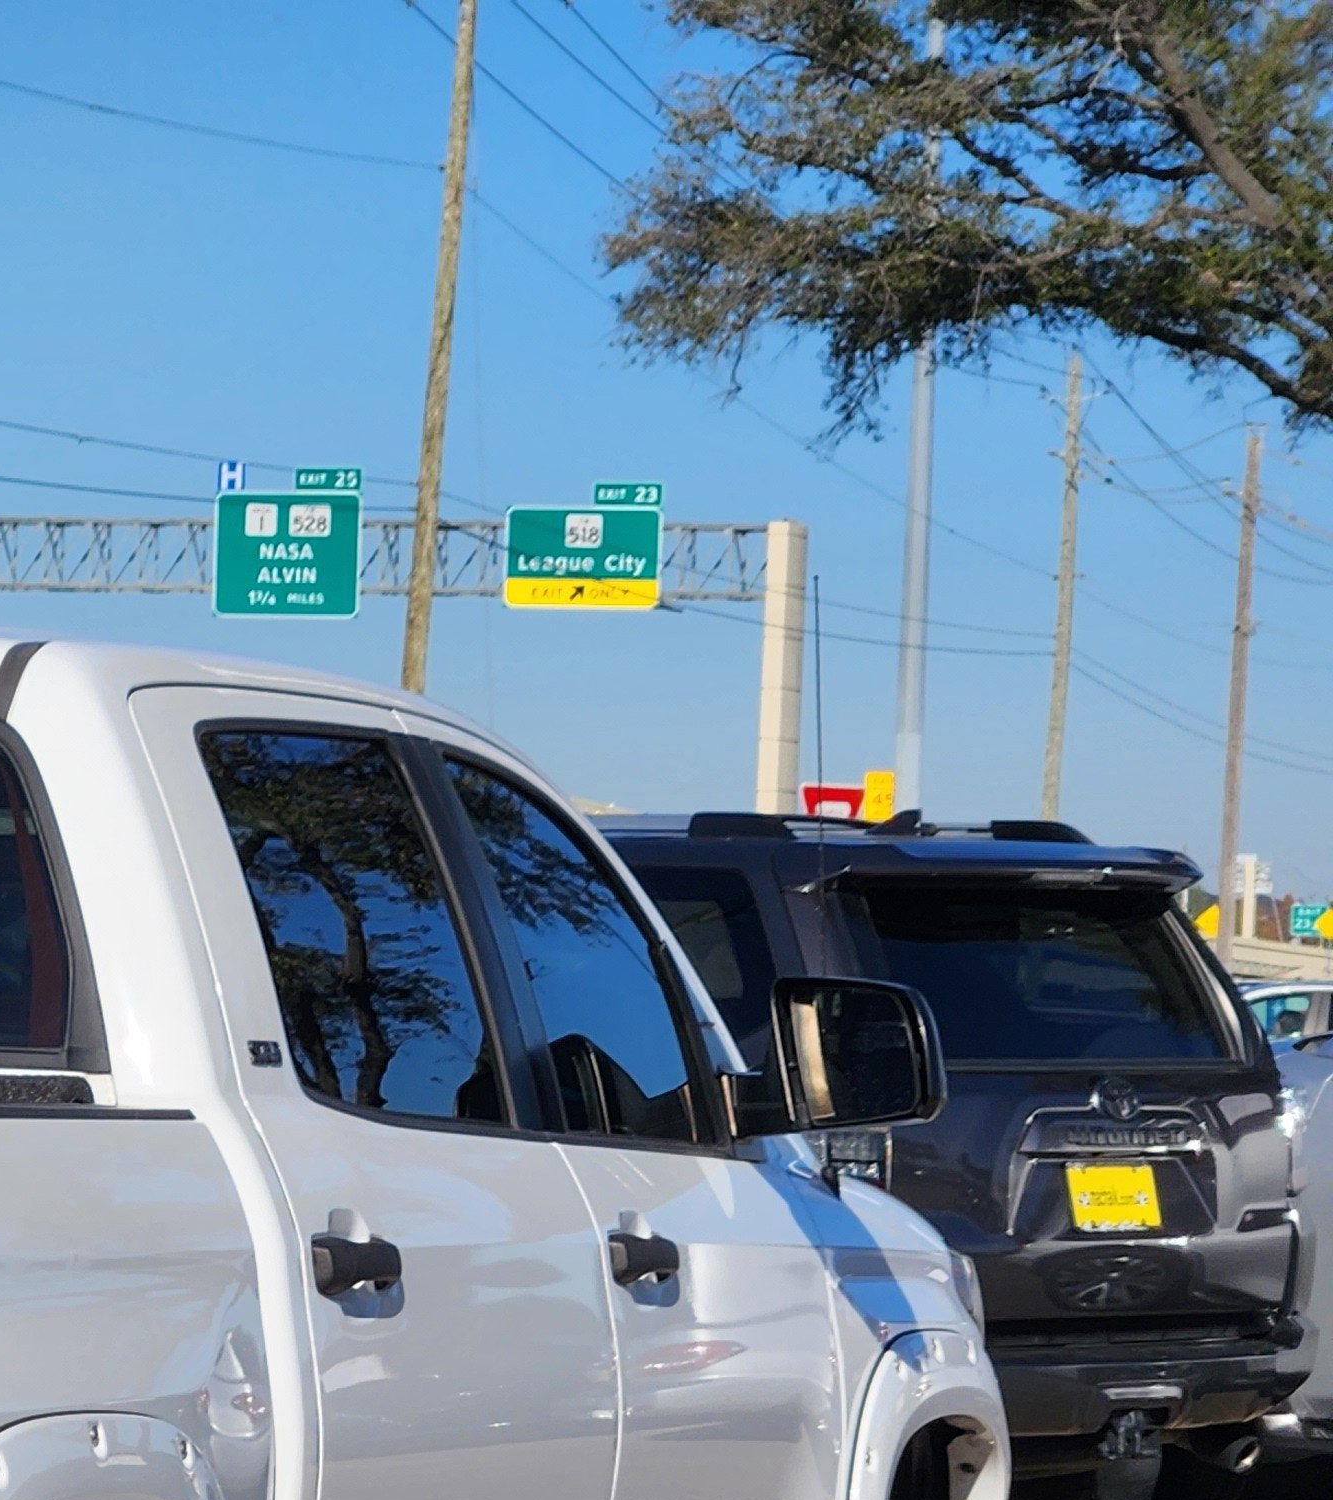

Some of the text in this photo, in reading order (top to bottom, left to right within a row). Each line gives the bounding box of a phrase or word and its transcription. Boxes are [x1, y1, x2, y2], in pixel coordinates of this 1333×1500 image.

[299, 470, 358, 488] EXIT 25
[597, 486, 659, 503] EXIT 23
[293, 515, 327, 533] 528
[567, 526, 600, 544] 518
[258, 542, 314, 561] NASA
[517, 553, 647, 577] League City
[257, 566, 317, 584] ALVIN
[286, 592, 325, 605] MILES
[531, 588, 563, 600] EXIT
